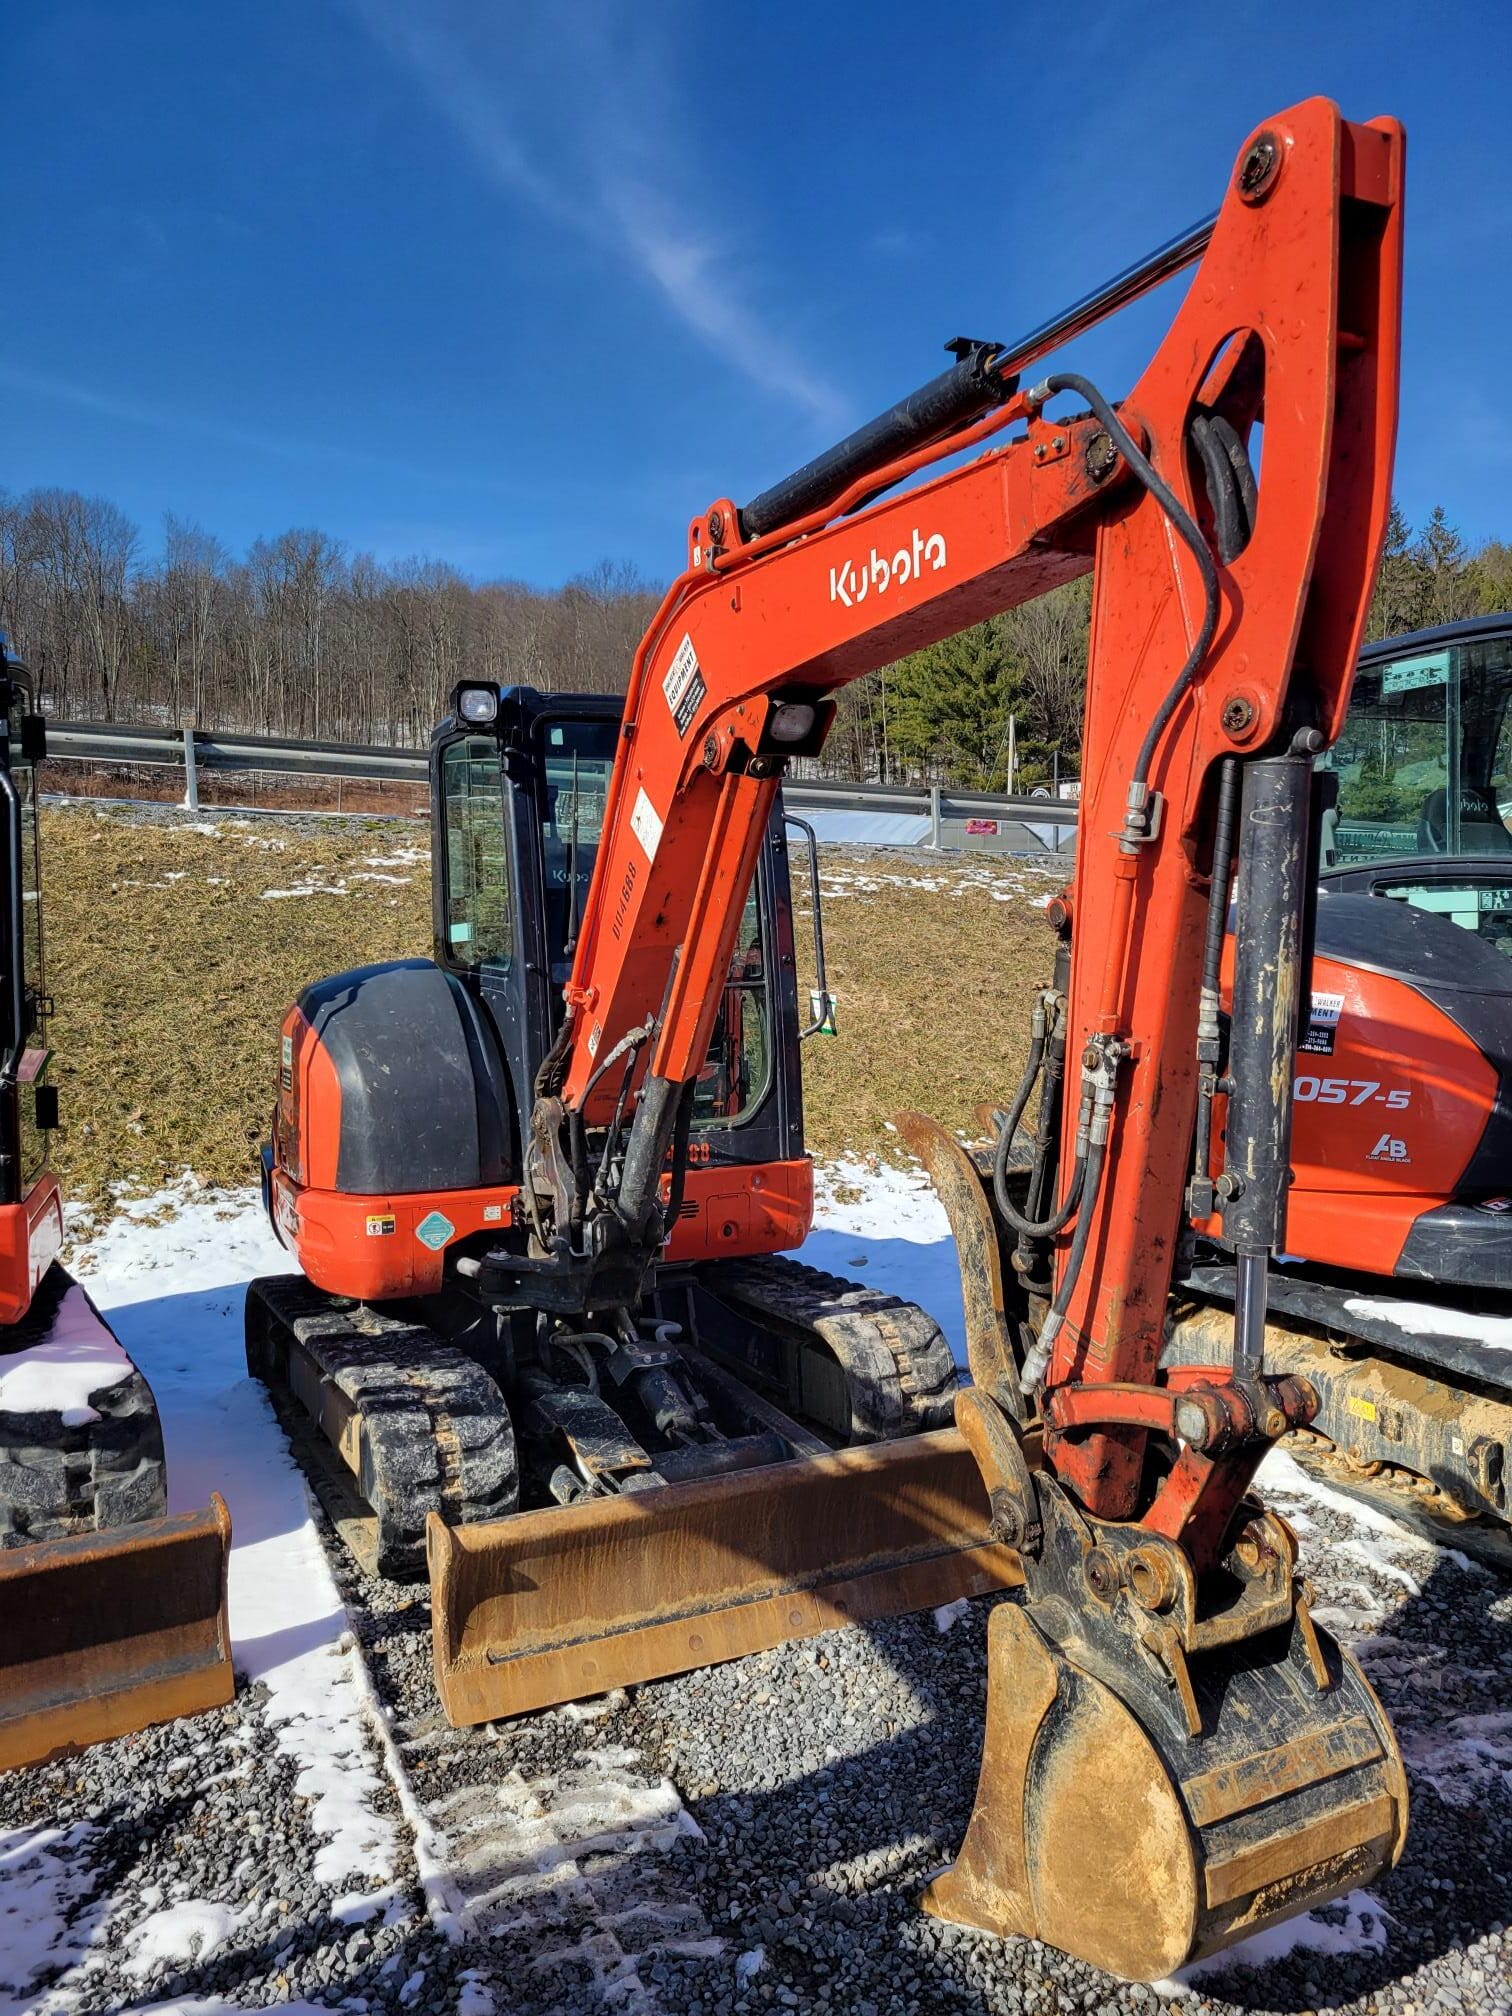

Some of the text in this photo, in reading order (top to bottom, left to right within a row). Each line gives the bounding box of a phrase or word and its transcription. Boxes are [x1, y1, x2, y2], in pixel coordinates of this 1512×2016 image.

[829, 528, 947, 607] Kubota
[668, 650, 694, 706] EQUIPMENT
[1293, 1076, 1412, 1109] 057-5
[1371, 1133, 1407, 1158] AB
